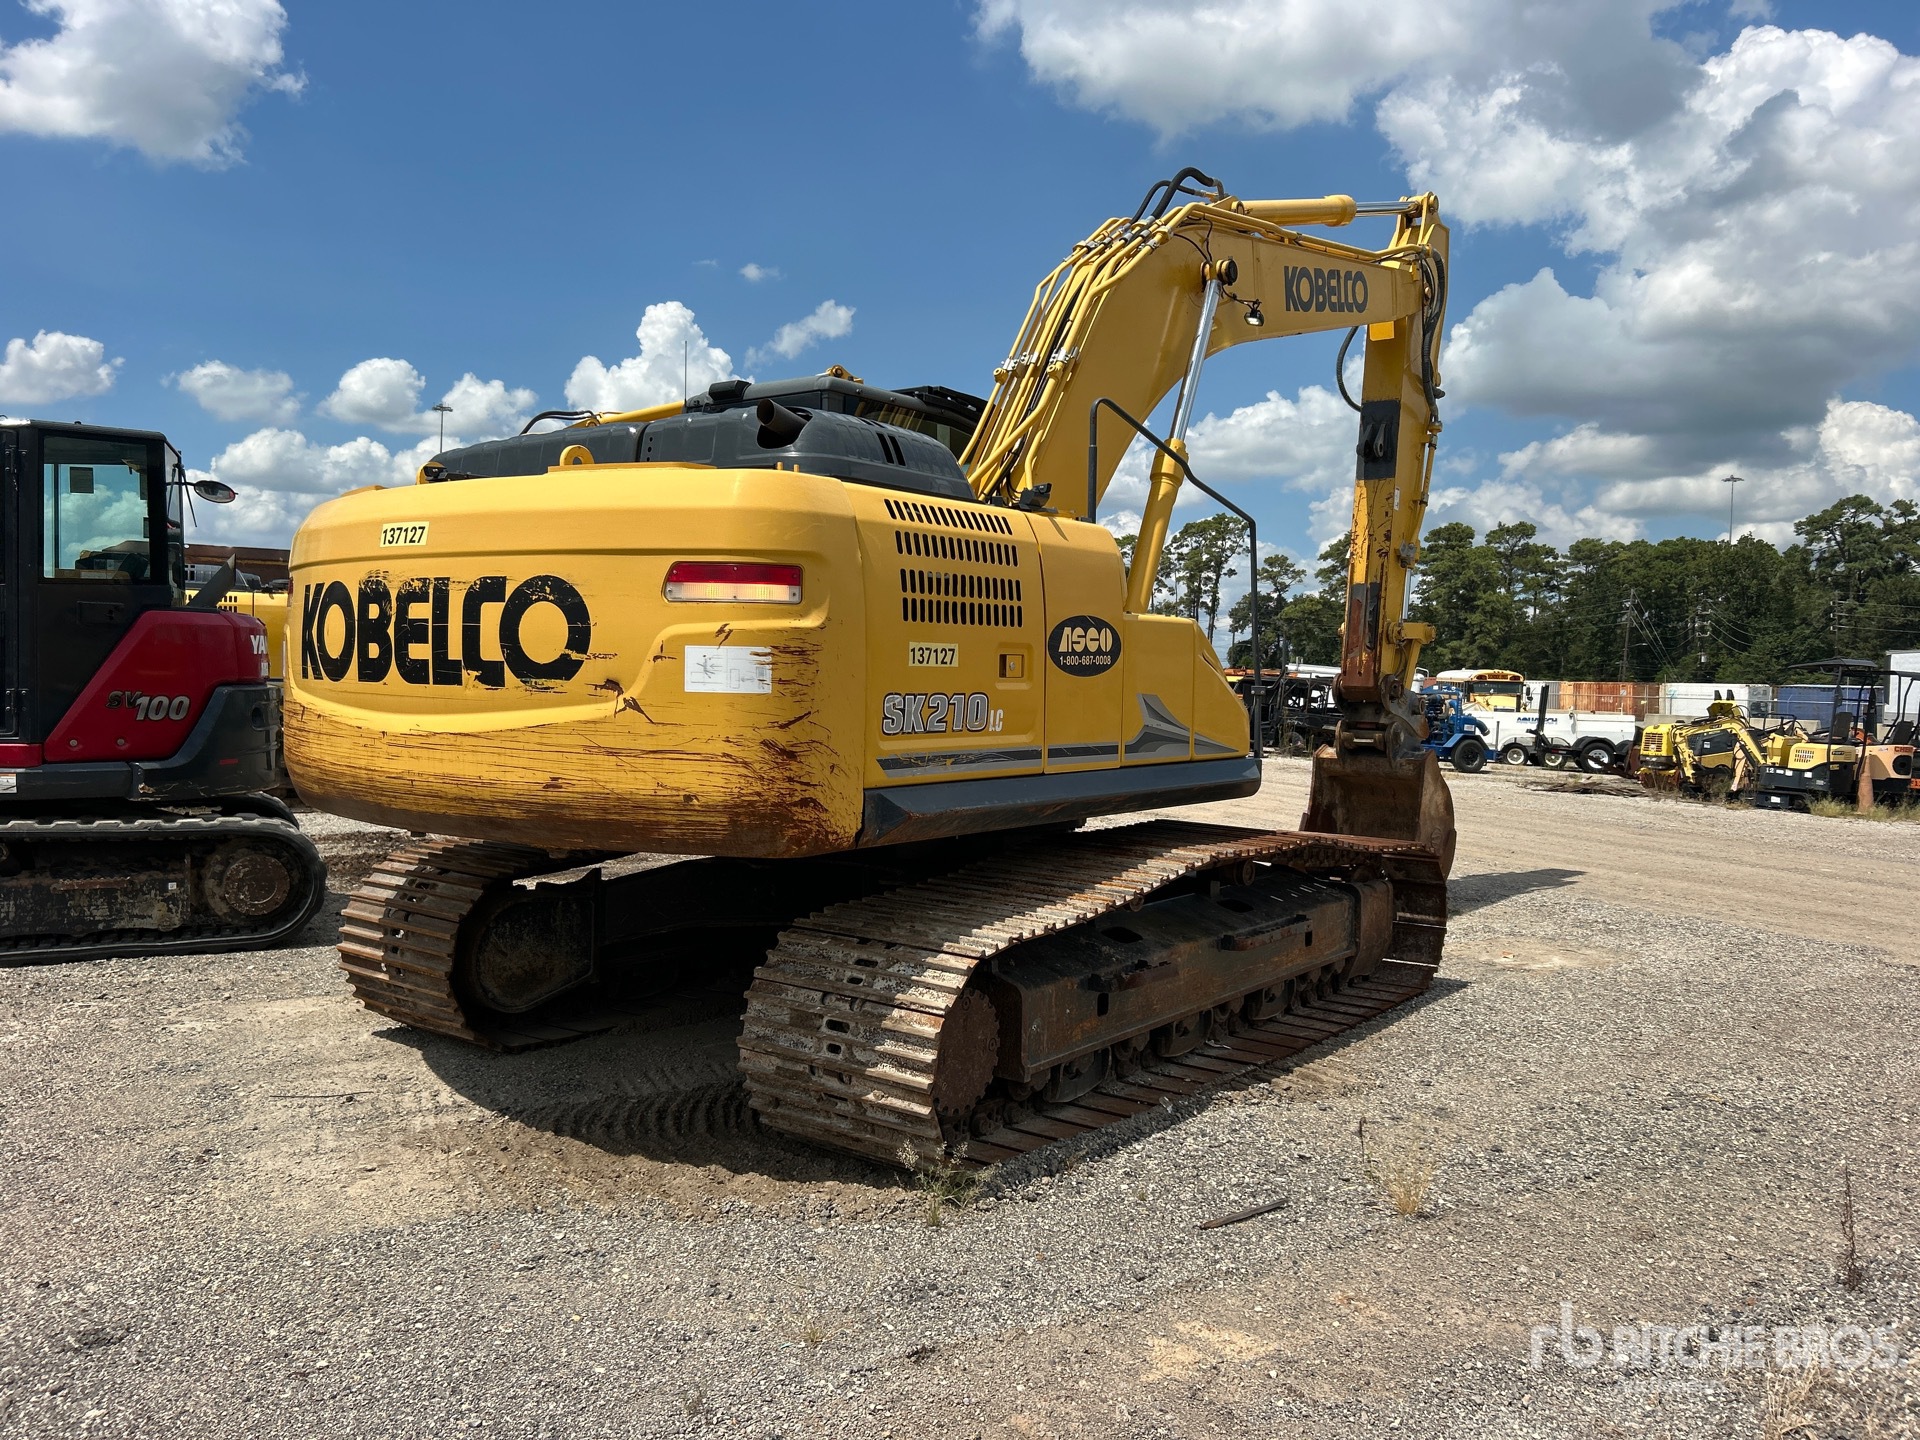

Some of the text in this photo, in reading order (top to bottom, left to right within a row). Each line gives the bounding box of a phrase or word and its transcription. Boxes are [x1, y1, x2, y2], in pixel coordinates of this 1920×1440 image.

[1284, 266, 1368, 313] KOBELCO
[383, 526, 426, 545] 137127
[302, 573, 591, 687] KOBELCO
[1058, 627, 1112, 653] ASCO
[250, 634, 267, 655] YA
[910, 647, 955, 666] 137127
[882, 691, 989, 735] SK210
